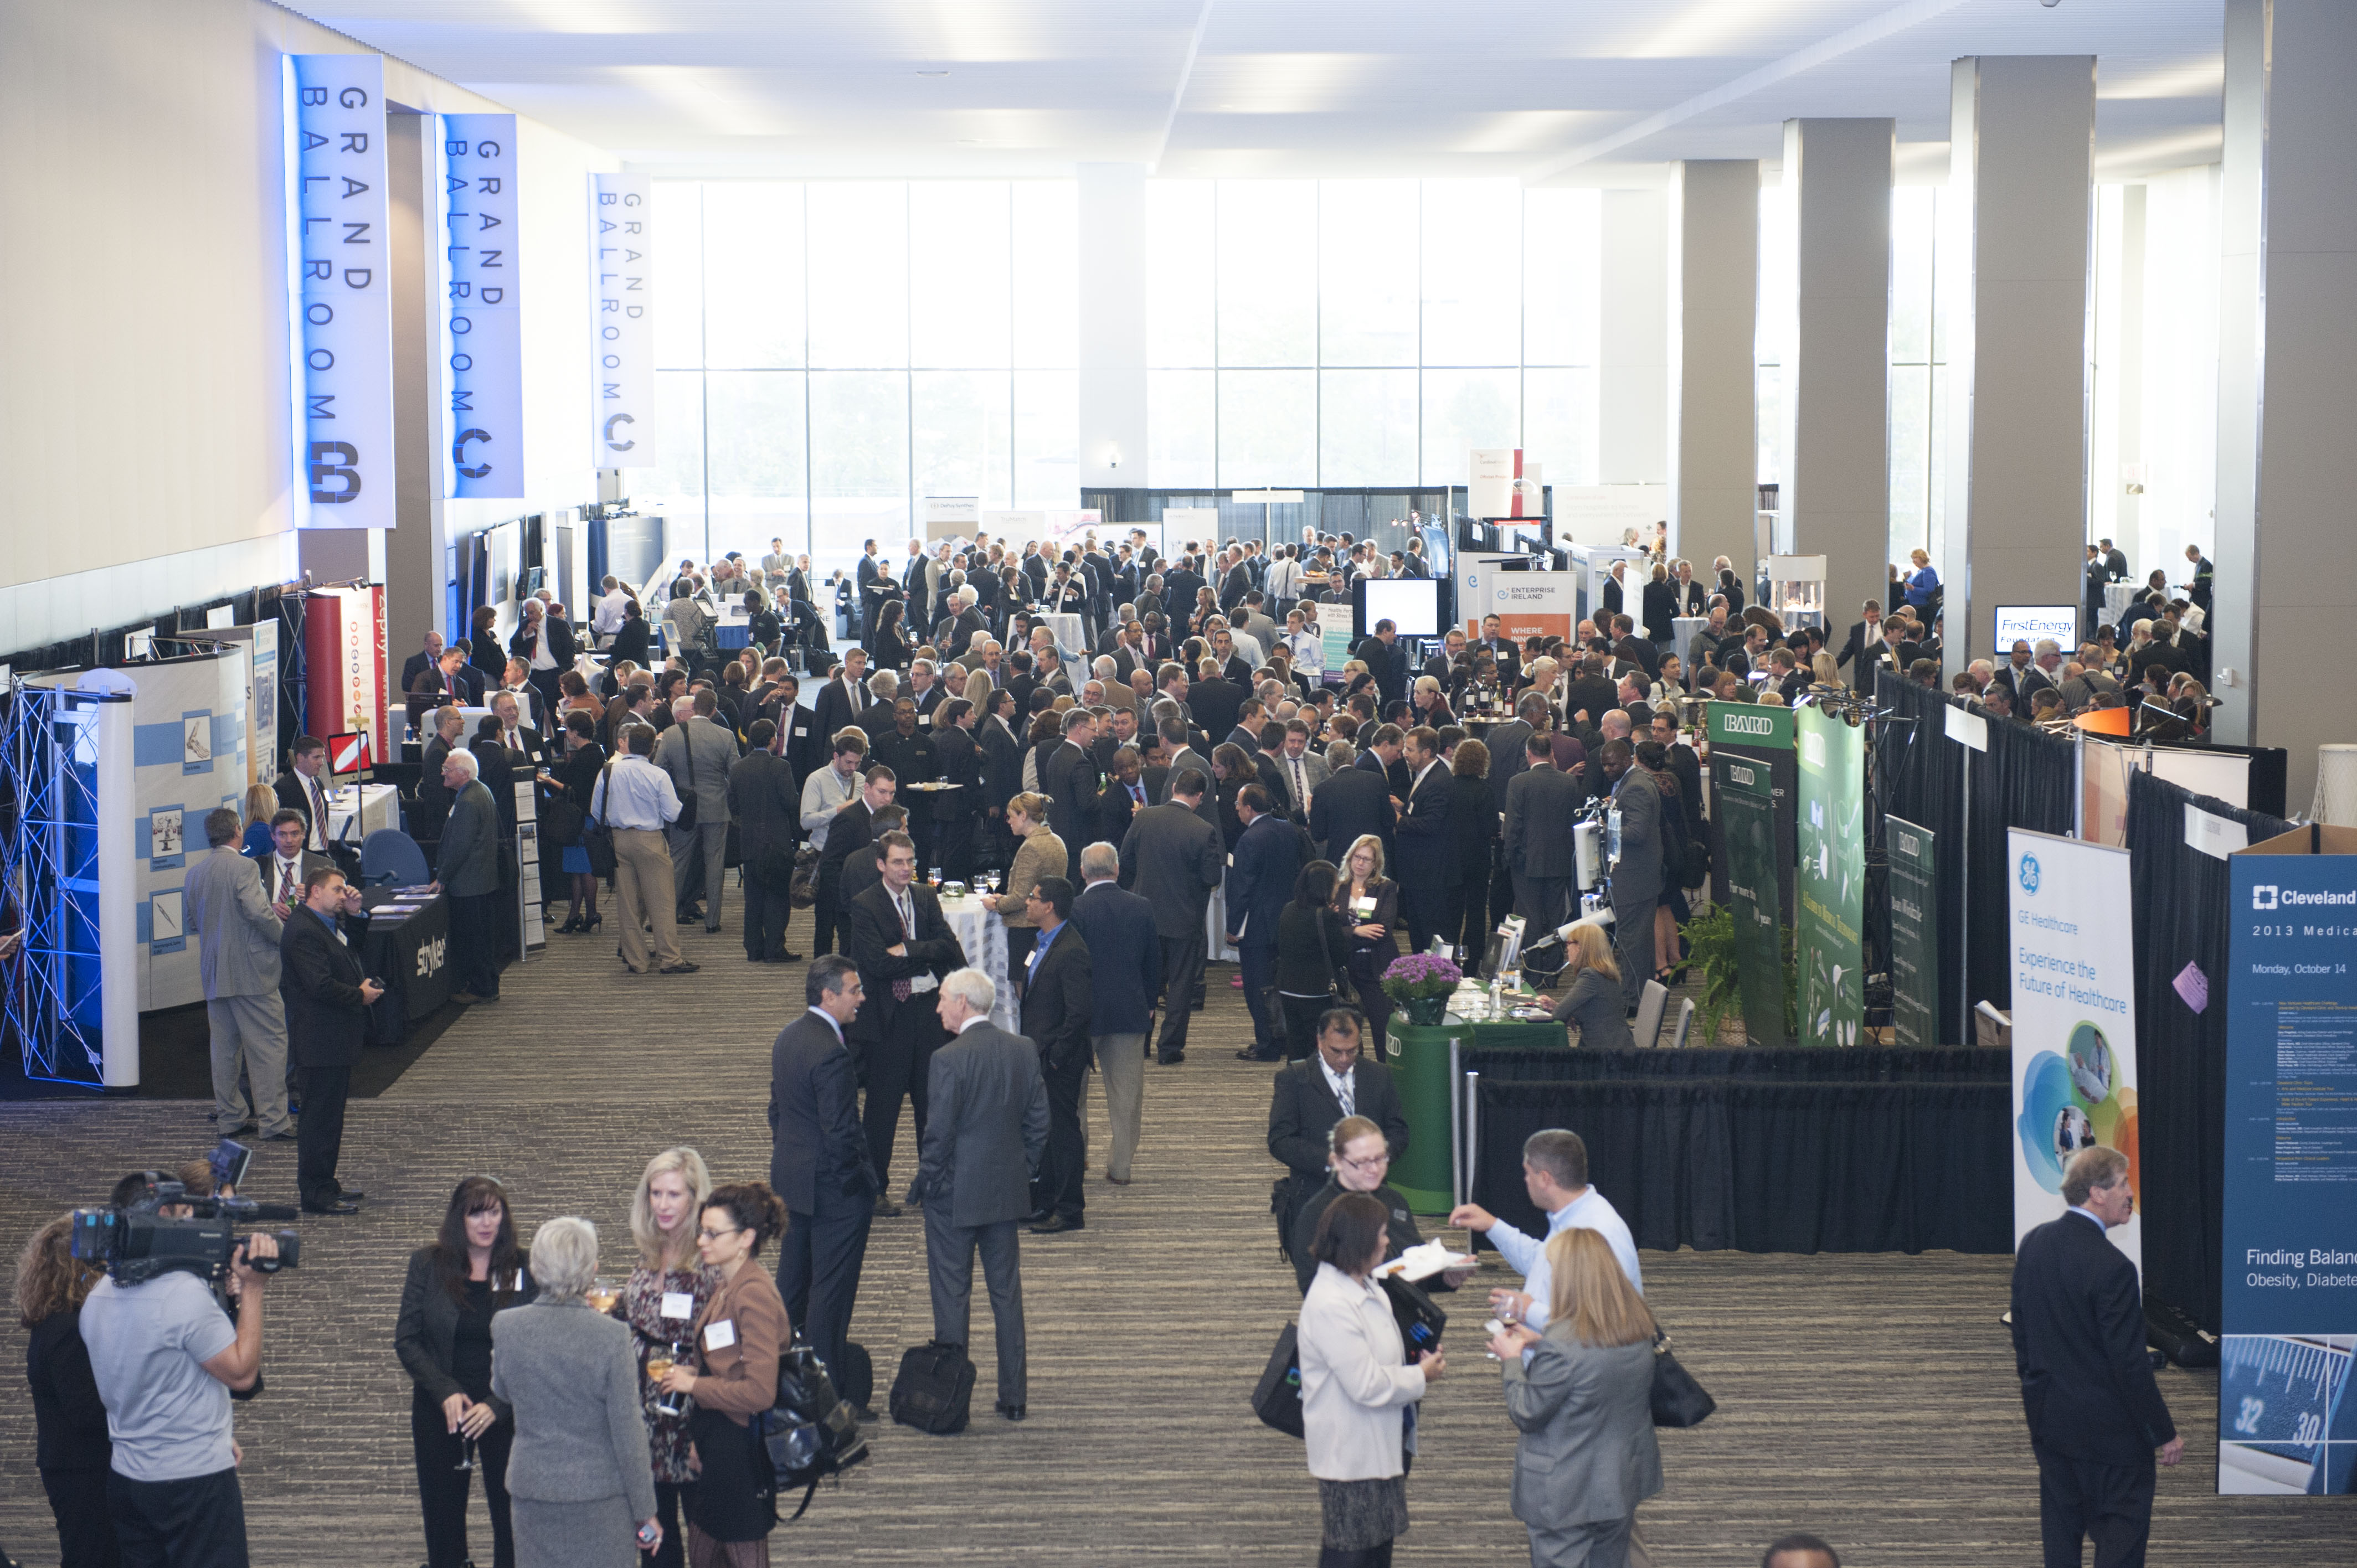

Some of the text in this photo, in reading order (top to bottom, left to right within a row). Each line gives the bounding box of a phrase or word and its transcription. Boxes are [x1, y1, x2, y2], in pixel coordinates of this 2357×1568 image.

[339, 87, 372, 289] GRAND
[477, 140, 503, 305] GRAND
[301, 86, 336, 420] BALLROOM
[624, 193, 642, 320] GRAND
[445, 140, 474, 411] BALLROOM
[600, 192, 621, 399] BALLROOM
[605, 412, 635, 452] C
[311, 441, 362, 504] B
[454, 428, 492, 479] C
[2003, 620, 2073, 633] FirstEnergy
[1725, 714, 1773, 735] BARD
[1730, 765, 1755, 786] BARD
[2281, 890, 2356, 904] Cleveland
[2018, 910, 2078, 935] GE Healthcare
[2252, 925, 2293, 936] 2013
[416, 935, 446, 978] stryker
[2019, 947, 2096, 981] Experience the
[2252, 963, 2346, 976] Monday, October 14
[2019, 972, 2127, 1014] Future of Healthcare
[2247, 1249, 2305, 1268] Finding
[2247, 1273, 2301, 1290] Obesity,
[2234, 1396, 2265, 1434] 32
[2292, 1411, 2320, 1449] 30
